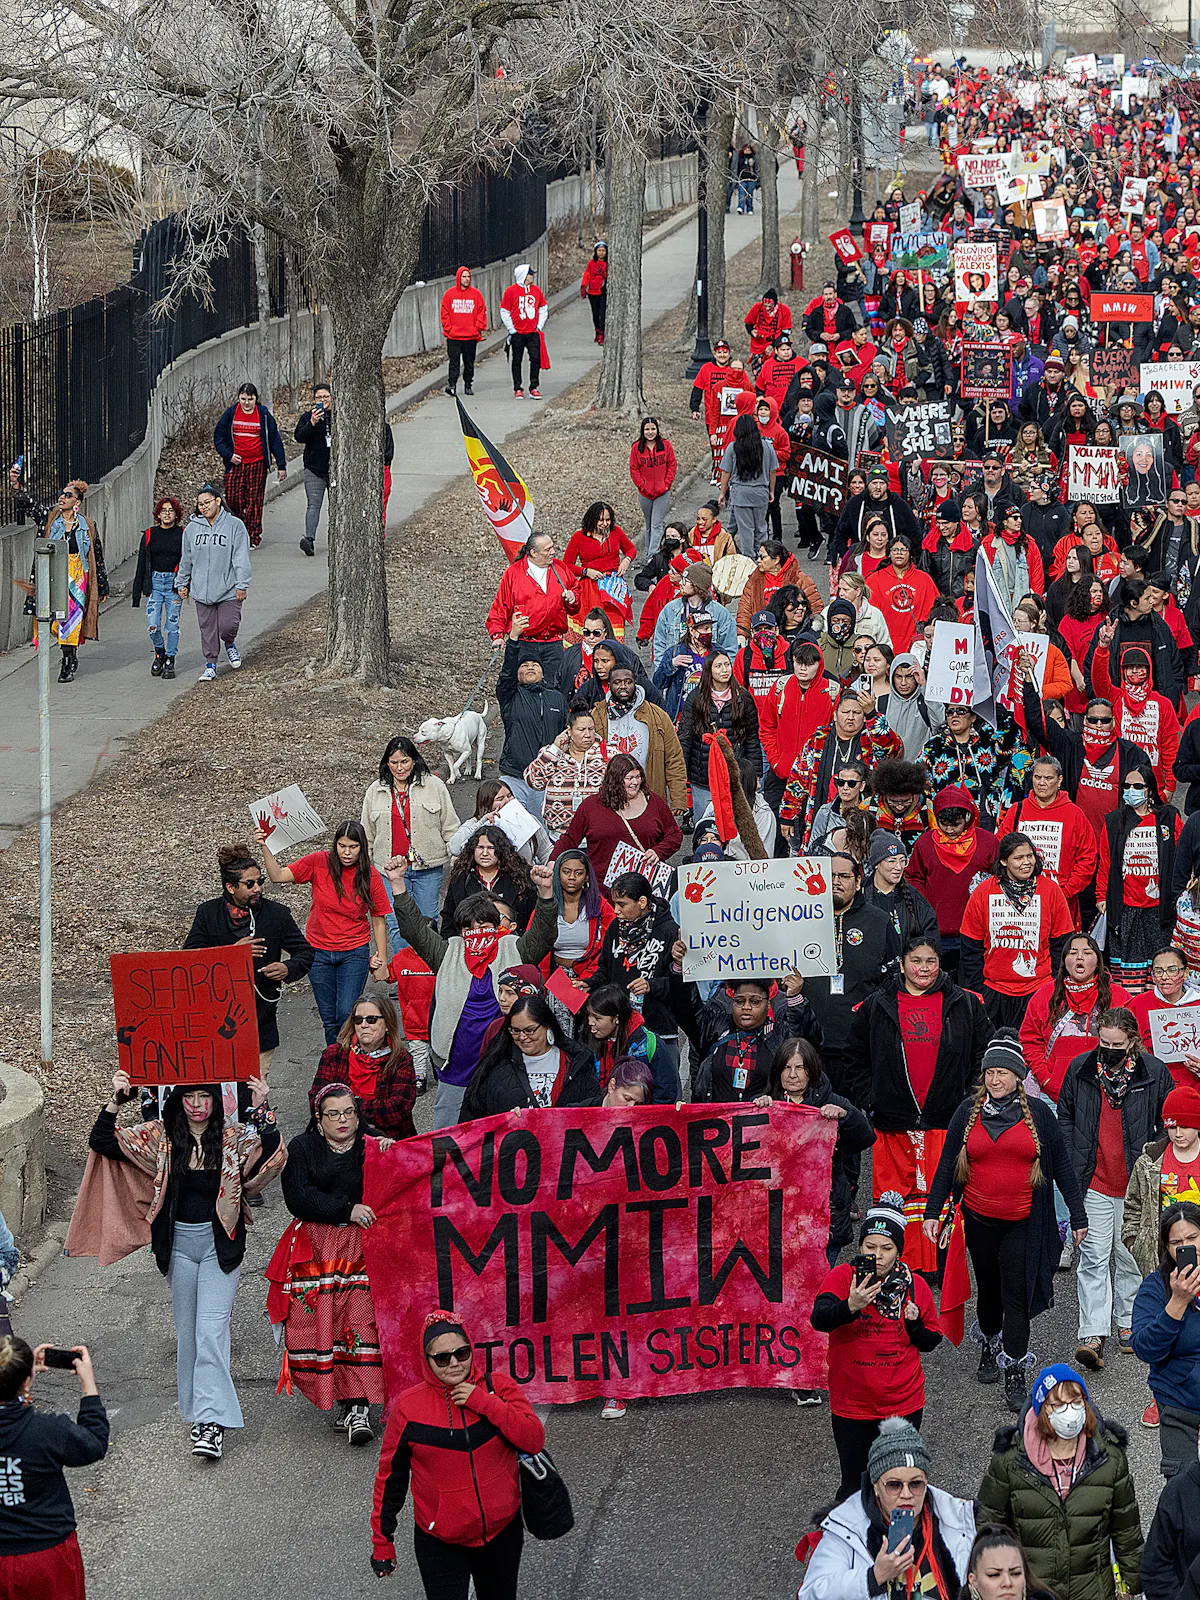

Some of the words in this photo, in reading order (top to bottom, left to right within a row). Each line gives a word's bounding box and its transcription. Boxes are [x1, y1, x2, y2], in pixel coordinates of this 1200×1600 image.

[892, 233, 945, 251] MMIW
[963, 245, 993, 254] LOVING
[959, 261, 991, 270] ALEXIS
[1102, 302, 1137, 313] MMIW
[1094, 350, 1134, 363] EVERY
[1153, 363, 1186, 372] SACRED
[1150, 380, 1192, 390] MMIWR
[886, 402, 950, 425] WHERE
[905, 421, 929, 438] IS
[901, 434, 935, 455] SHE
[1074, 446, 1093, 457] YOU
[1095, 448, 1113, 458] ARE
[791, 476, 843, 510] NEXT?
[1070, 492, 1079, 500] NO
[1080, 492, 1099, 503] MORE
[195, 534, 227, 547] UTTC
[929, 686, 944, 695] RIP
[1081, 778, 1112, 790] adidas
[734, 862, 768, 875] STOP
[749, 880, 786, 892] Violence
[130, 960, 254, 1010] SEARCH
[148, 1012, 207, 1039] THE
[429, 1128, 543, 1209] NO
[556, 1114, 772, 1201] MORE
[432, 1189, 784, 1326] MMIW
[473, 1330, 630, 1385] TOLEN
[647, 1322, 802, 1375] SISTERS
